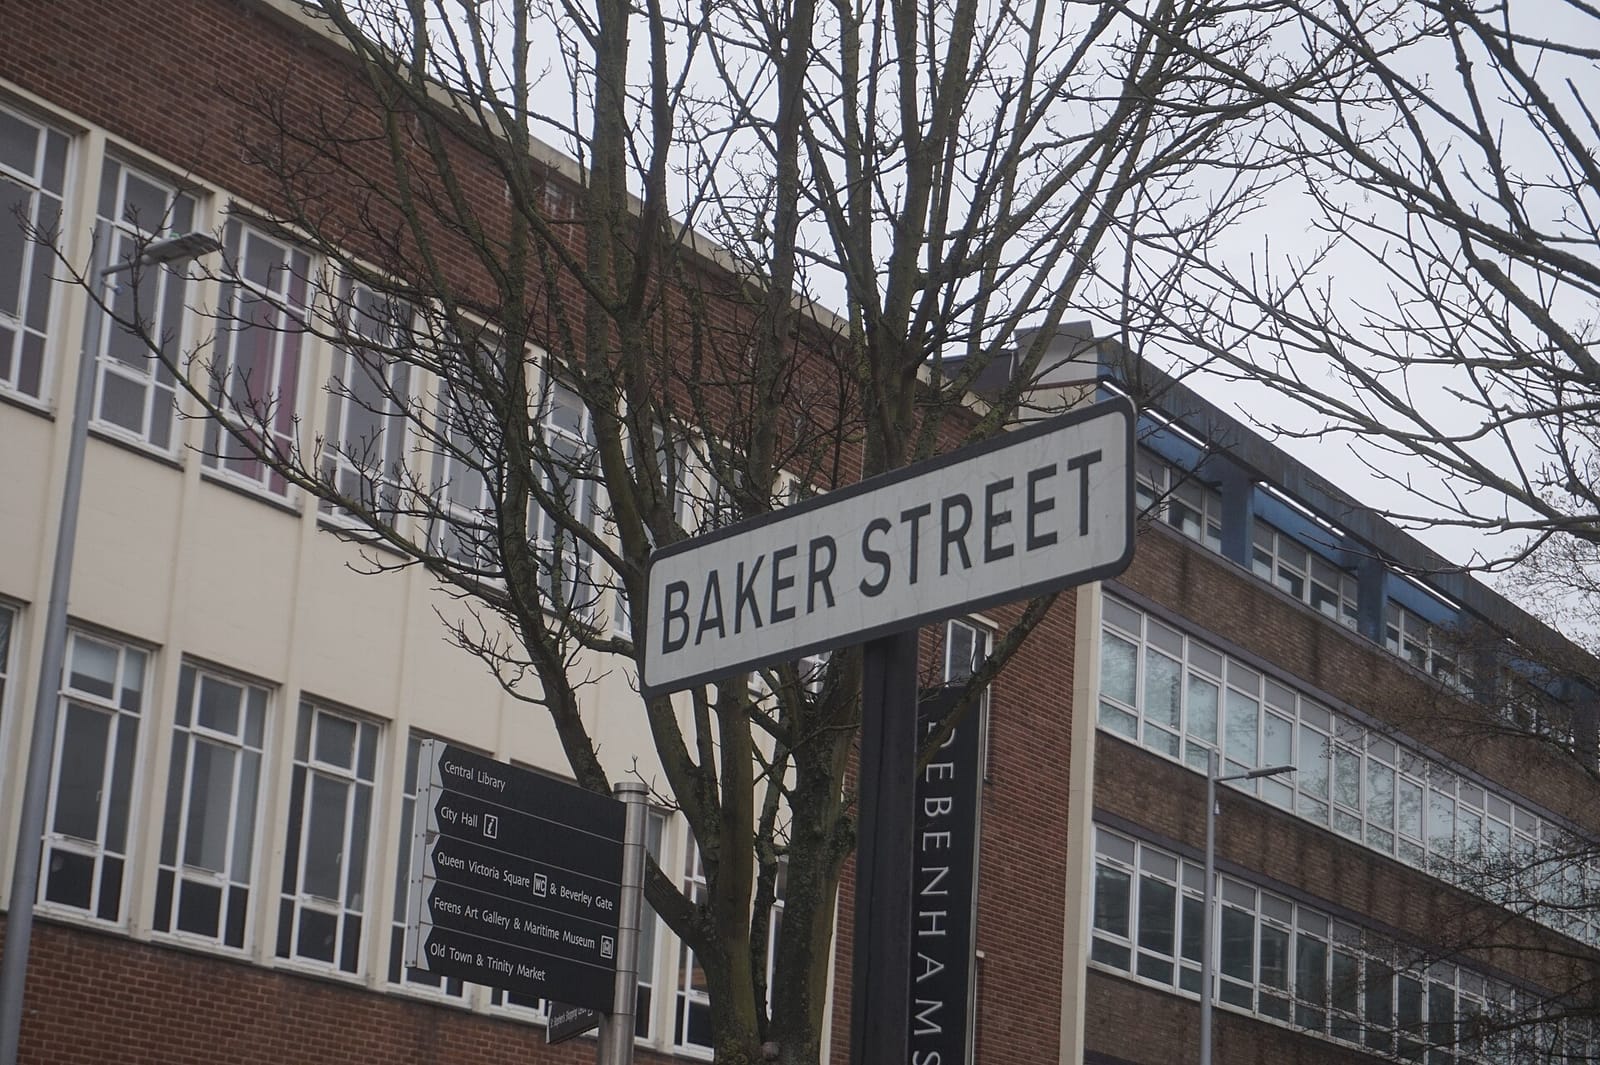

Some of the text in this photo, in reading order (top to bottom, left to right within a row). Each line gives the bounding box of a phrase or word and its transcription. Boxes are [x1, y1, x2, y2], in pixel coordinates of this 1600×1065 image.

[661, 449, 1103, 655] BAKER STREET
[444, 761, 506, 792] Central Library
[440, 806, 458, 824] City
[461, 812, 478, 828] Hall
[437, 851, 613, 911] Queen Victoria Square WC & Beverley Gate
[434, 897, 595, 949] Ferens Art Gallery & Maritime Museum
[430, 943, 546, 981] Old Town & Trinity Market
